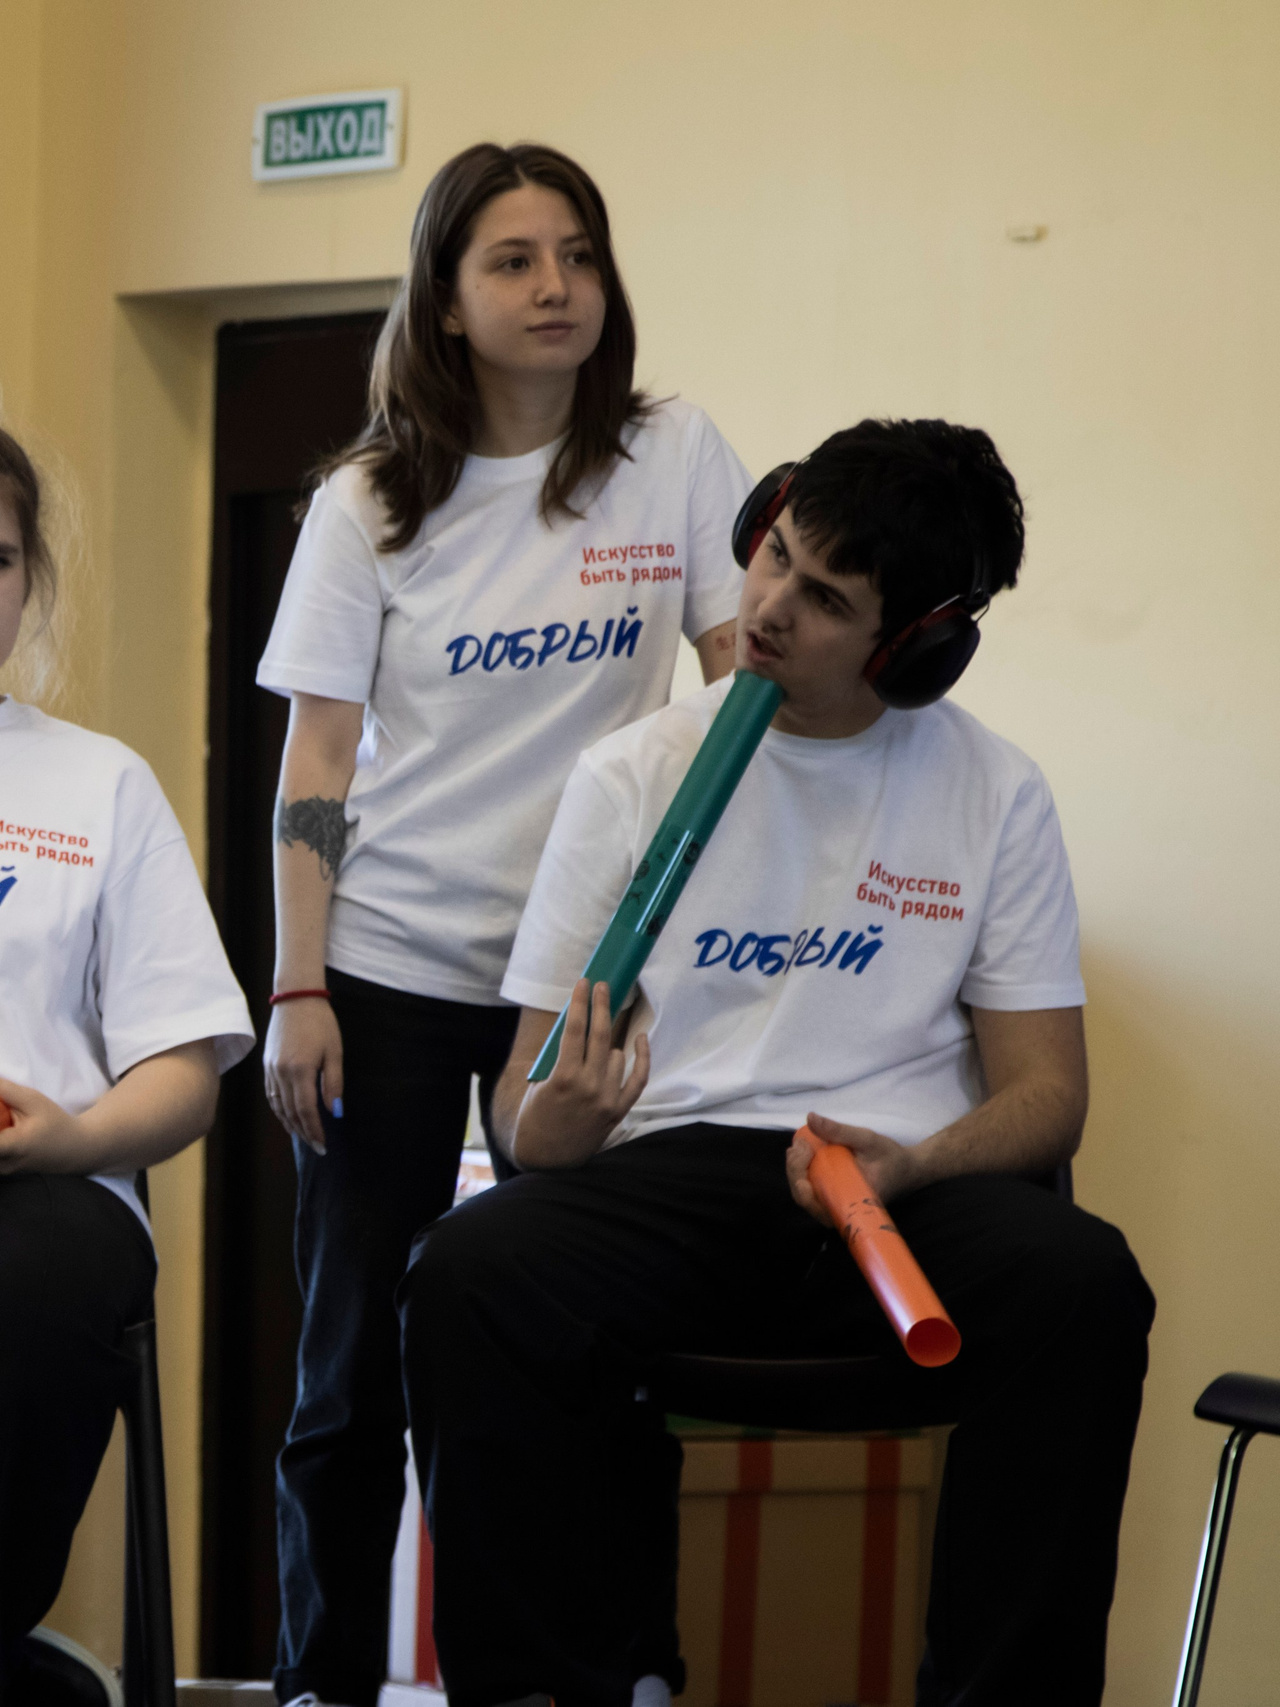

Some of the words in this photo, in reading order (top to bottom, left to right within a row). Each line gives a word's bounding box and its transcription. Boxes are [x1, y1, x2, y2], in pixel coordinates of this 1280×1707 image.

[270, 107, 382, 161] ВЫХОД
[582, 543, 676, 565] Искусство
[580, 569, 626, 587] быть
[631, 566, 682, 586] рядом
[445, 605, 643, 676] ДОБРЫЙ
[36, 845, 95, 867] рядом
[868, 860, 961, 897] Искусство
[856, 882, 896, 911] быть
[901, 900, 965, 922] рядом
[694, 924, 885, 977] ДОБРЫЙ
